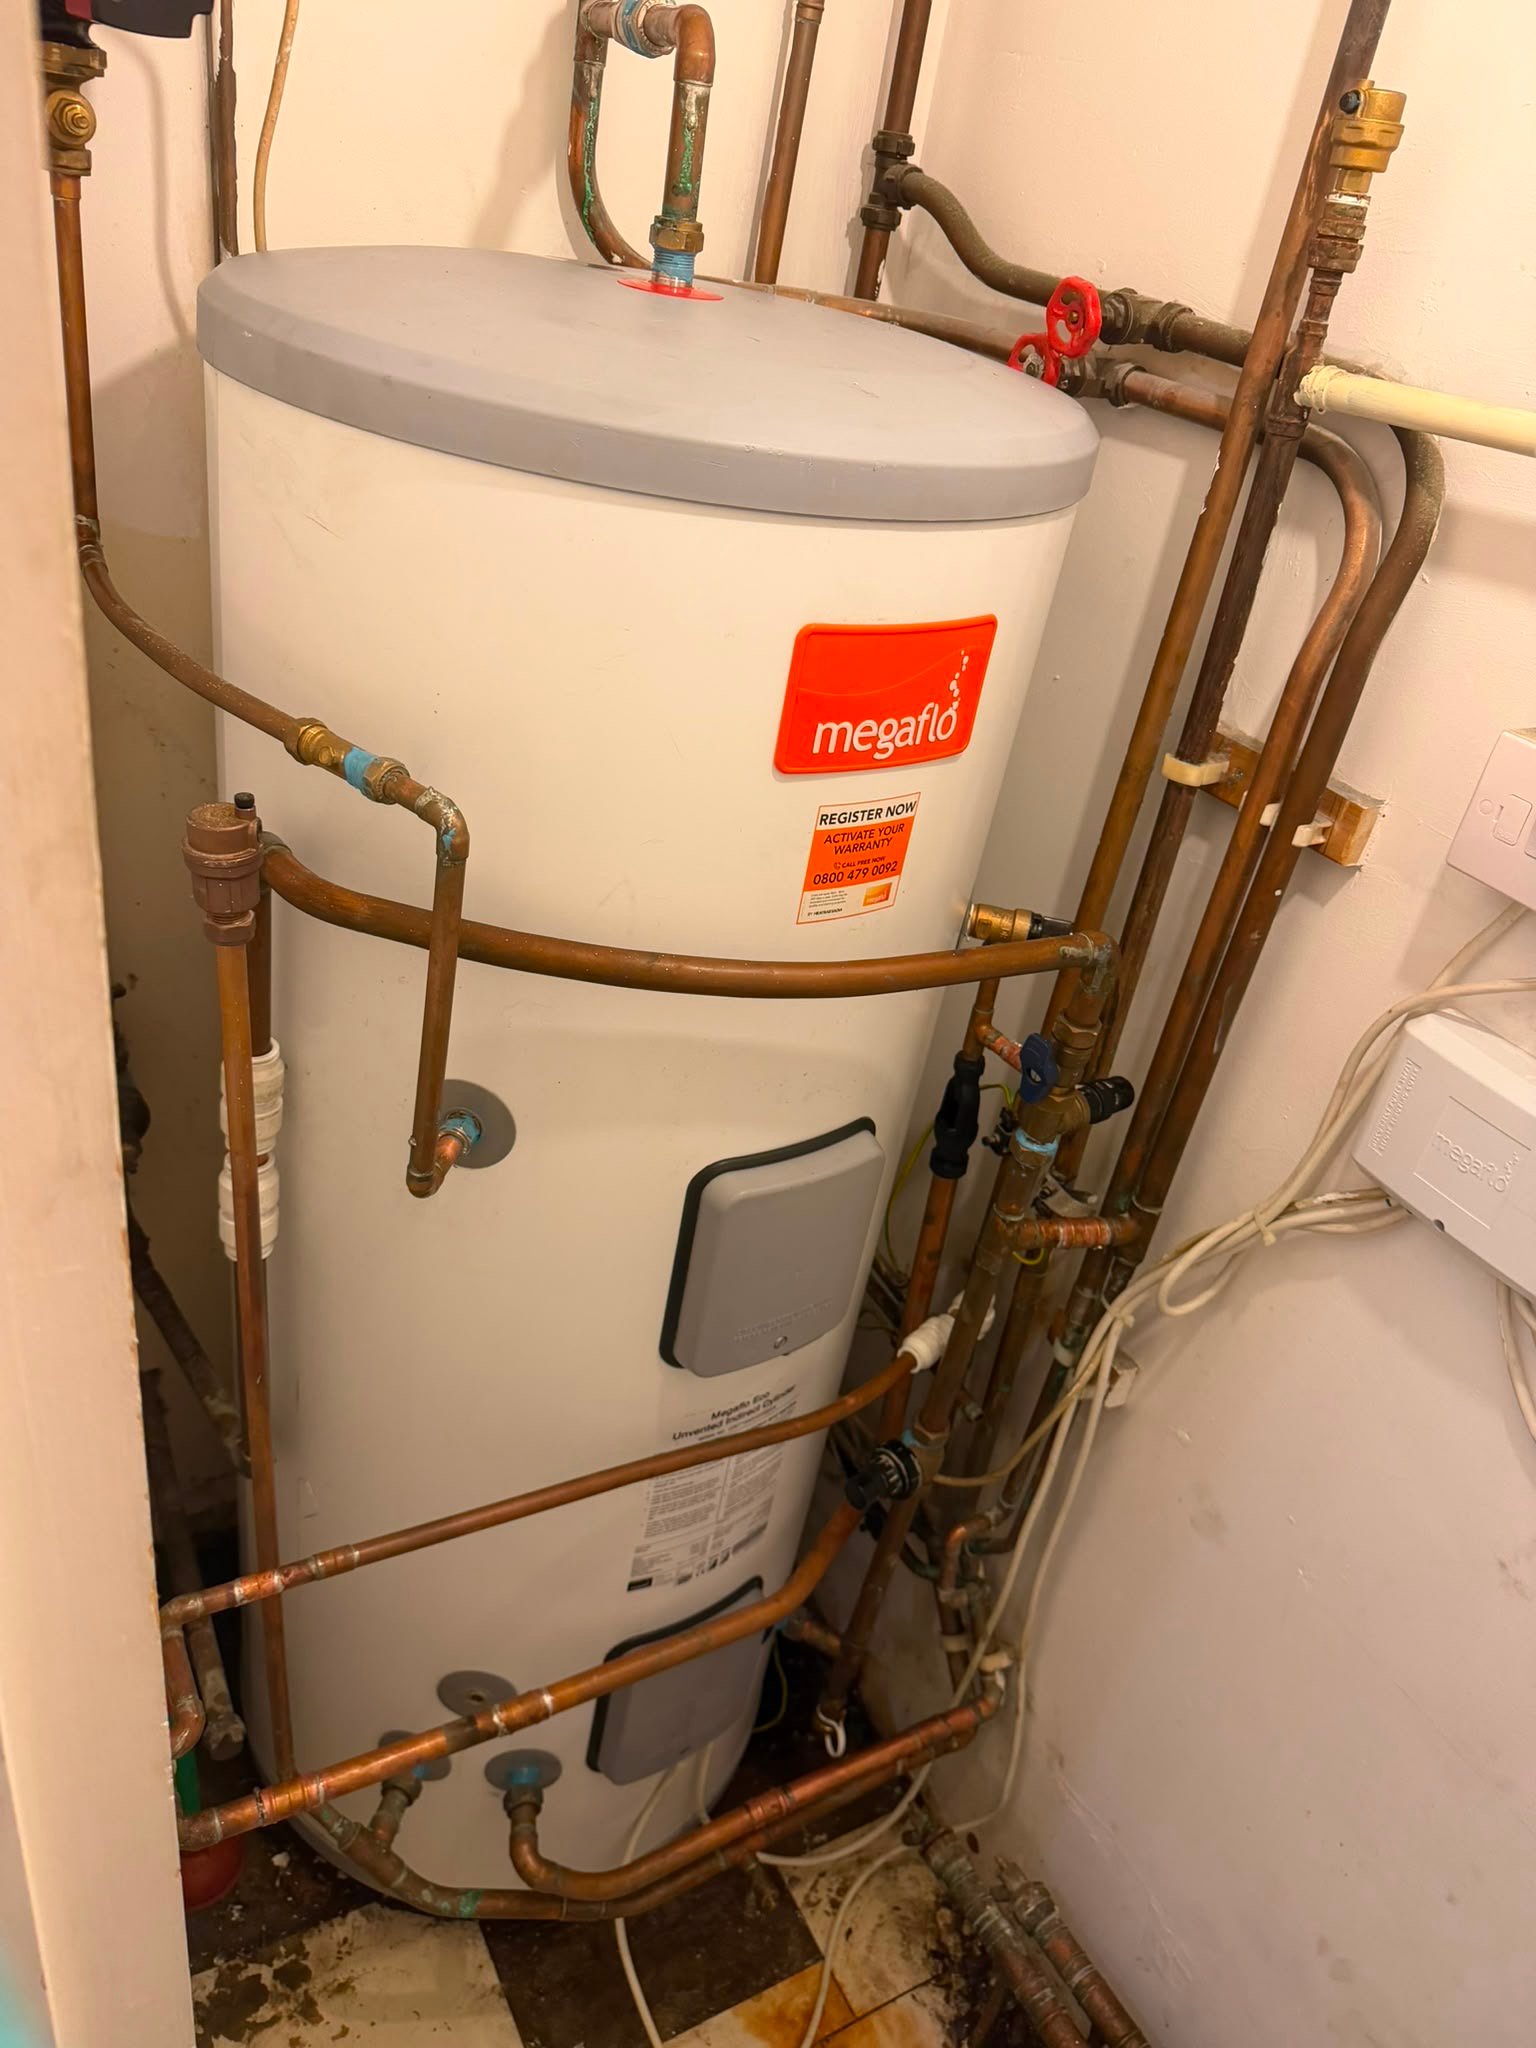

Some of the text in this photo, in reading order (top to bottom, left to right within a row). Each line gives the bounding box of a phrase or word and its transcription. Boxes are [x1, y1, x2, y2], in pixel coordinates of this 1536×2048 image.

[812, 702, 957, 760] megaflo
[819, 800, 917, 826] REGISTER NOW
[823, 823, 905, 845] ACTIVATE YOUR
[834, 837, 893, 855] WARRANTY
[813, 860, 898, 885] 0800 479 0092
[842, 856, 887, 869] CALL FREE NOW
[711, 1400, 751, 1420] Megaflo
[752, 1391, 770, 1404] Eco
[672, 1419, 724, 1441] Unvented
[725, 1403, 761, 1425] Indirect
